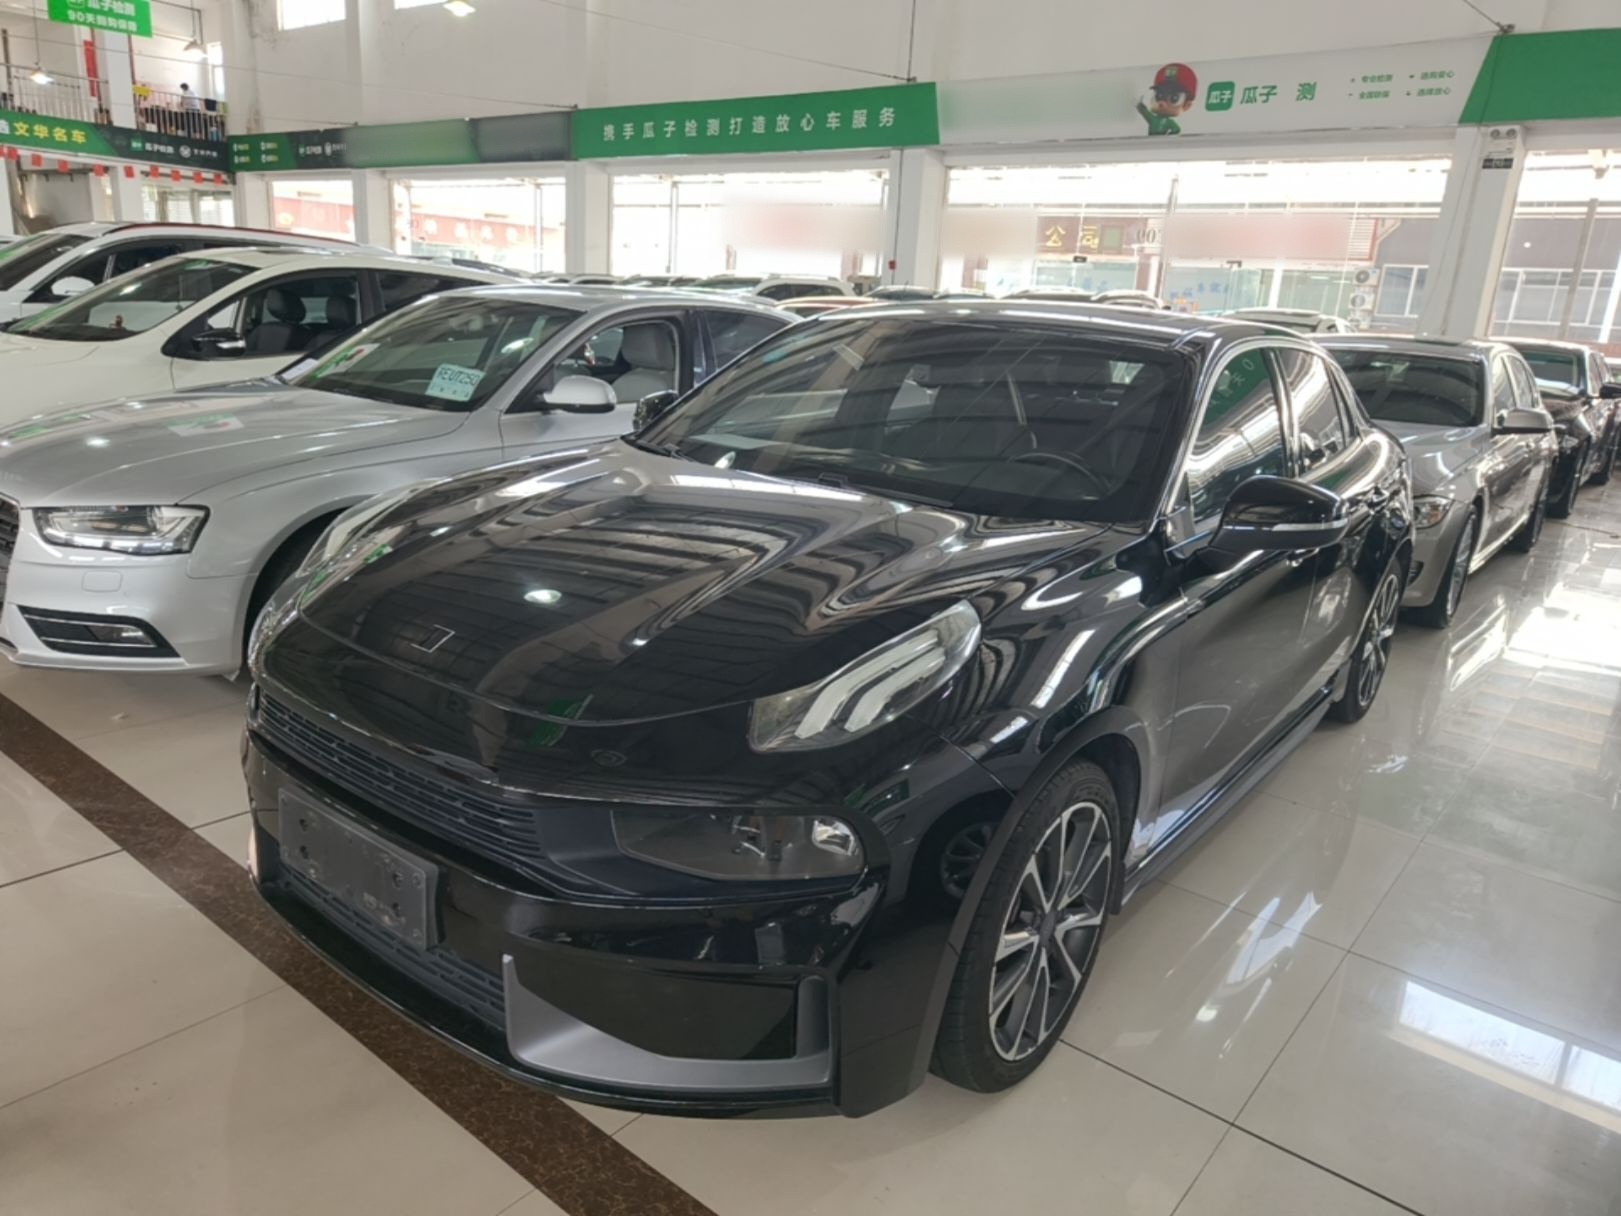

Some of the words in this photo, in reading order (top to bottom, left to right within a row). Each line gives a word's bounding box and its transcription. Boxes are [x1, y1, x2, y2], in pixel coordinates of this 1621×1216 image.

[1240, 85, 1278, 105] 瓜子
[14, 121, 87, 144] 文华名车
[603, 107, 895, 141] 携手瓜子检测打造放心车服务
[1045, 224, 1099, 249] 公司
